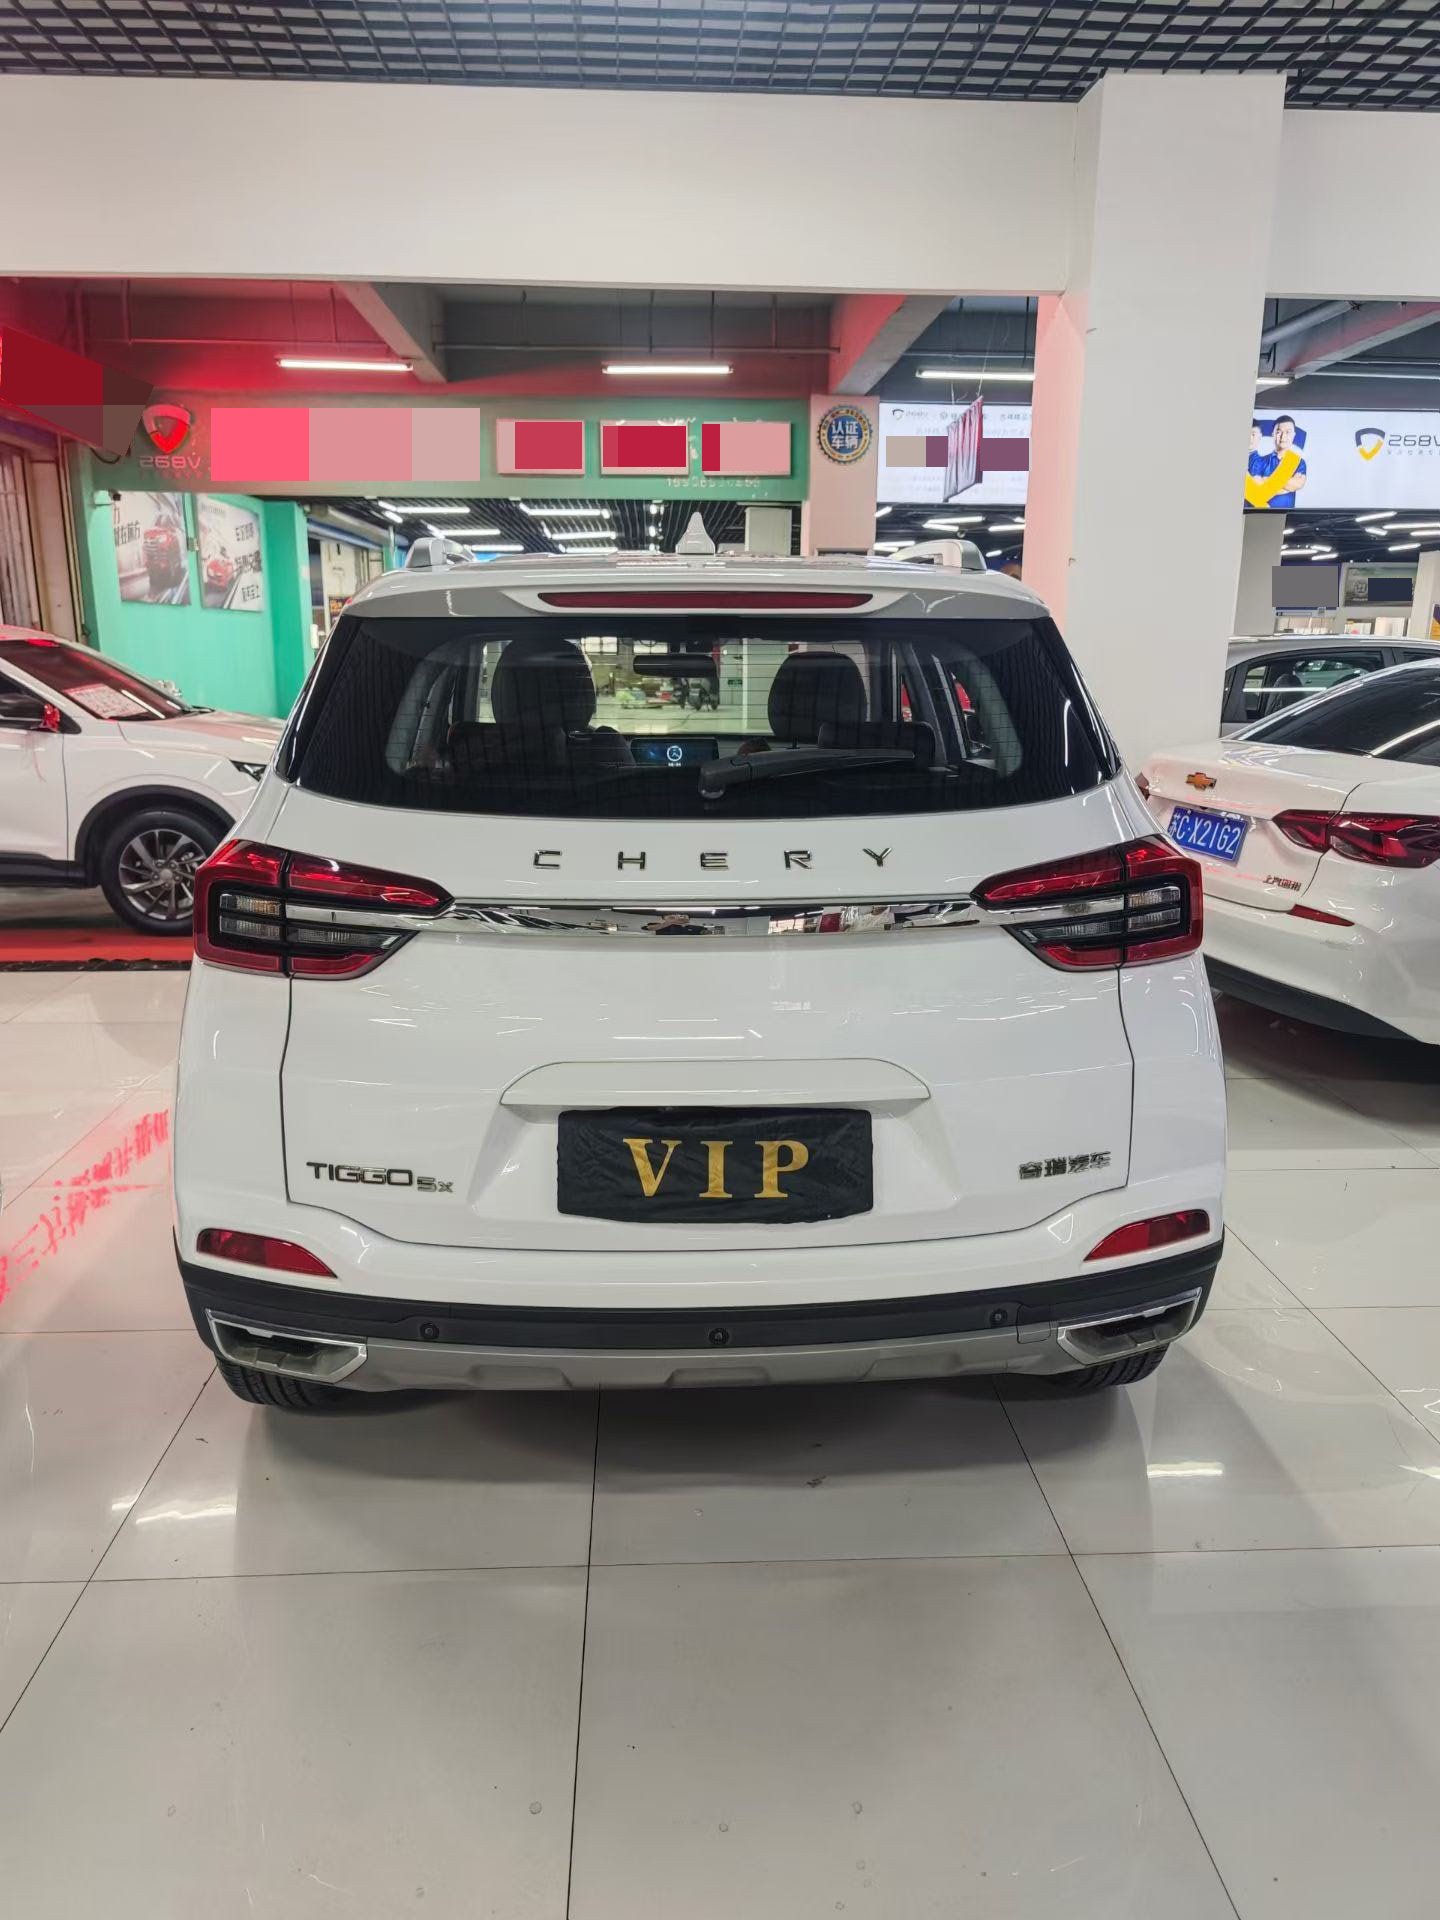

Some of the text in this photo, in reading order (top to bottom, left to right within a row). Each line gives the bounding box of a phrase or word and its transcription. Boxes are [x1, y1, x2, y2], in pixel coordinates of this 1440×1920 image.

[831, 420, 859, 434] 认证
[831, 435, 859, 449] 车辆
[139, 455, 201, 470] 268V
[532, 847, 892, 870] CHERY
[306, 1161, 413, 1187] TIGGO
[622, 1138, 809, 1199] VIP
[1019, 1150, 1111, 1180] 奇瑞汽车
